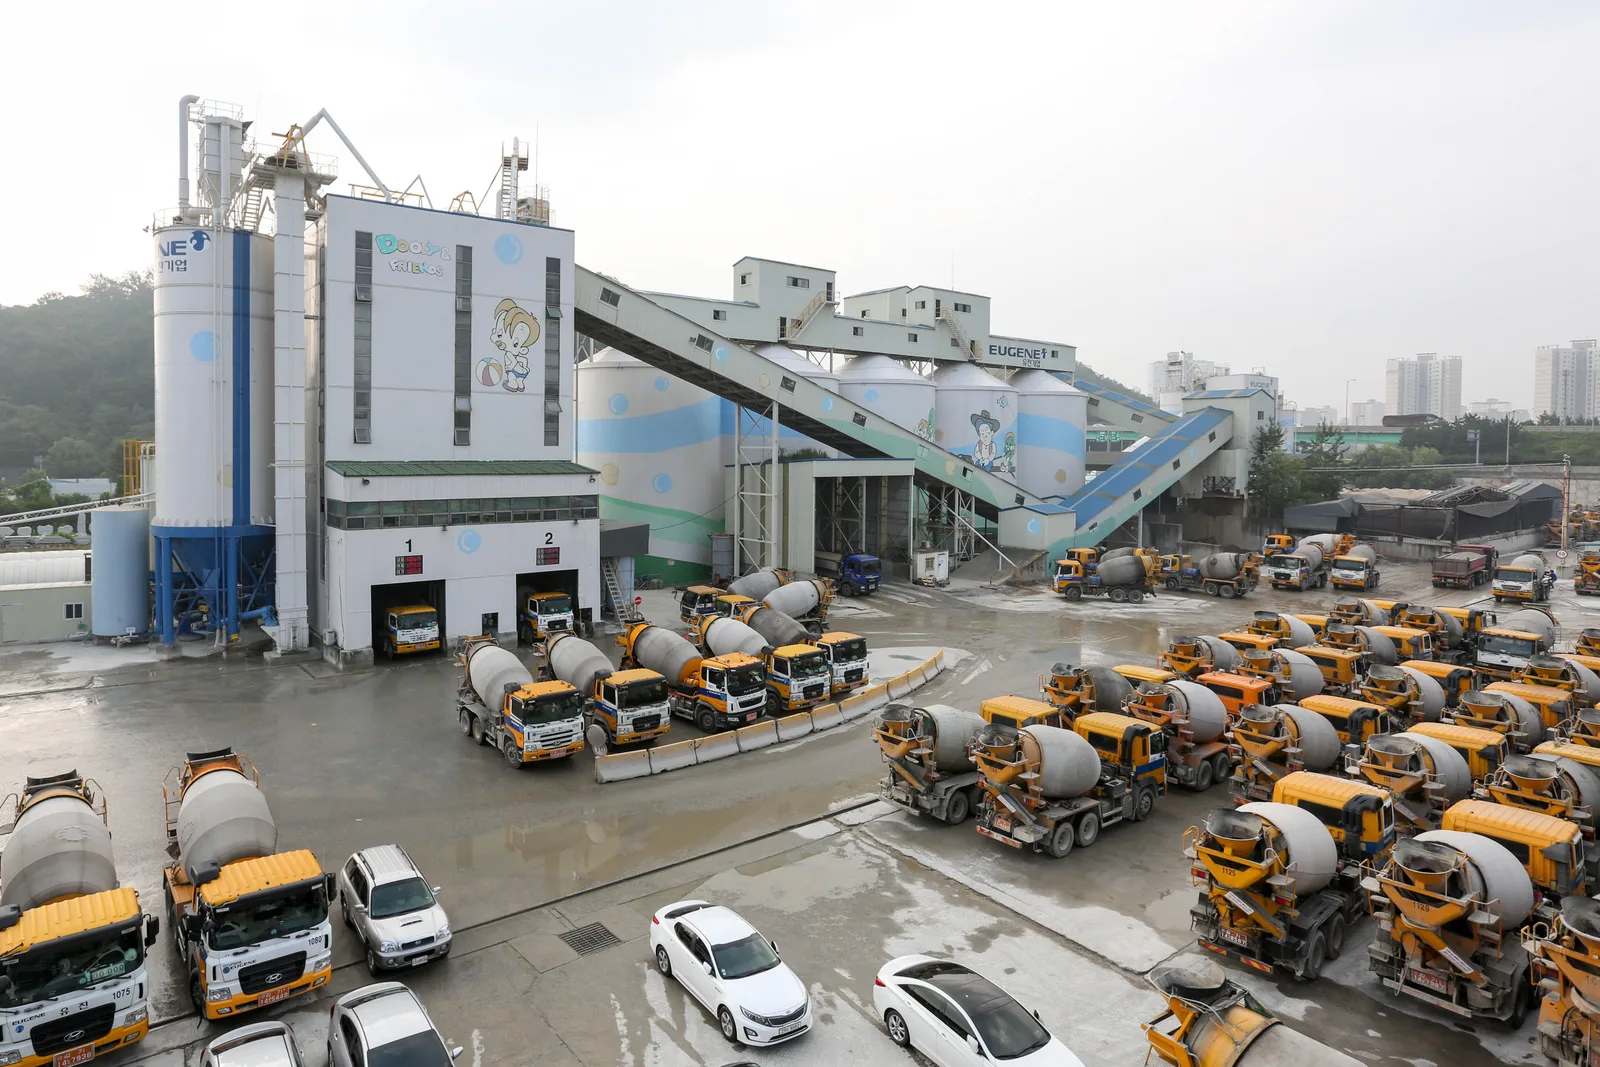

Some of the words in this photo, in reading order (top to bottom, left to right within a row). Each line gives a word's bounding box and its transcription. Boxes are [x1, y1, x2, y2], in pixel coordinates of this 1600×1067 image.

[375, 233, 440, 256] DOOLY
[440, 246, 451, 260] &
[388, 259, 444, 277] FRIENDS
[989, 344, 1041, 360] EUGENE
[405, 538, 412, 553] 1
[545, 532, 554, 545] 2
[1222, 867, 1237, 877] 1125
[308, 936, 323, 946] 1080
[112, 987, 131, 1000] 1075
[12, 1012, 46, 1026] EUGENE
